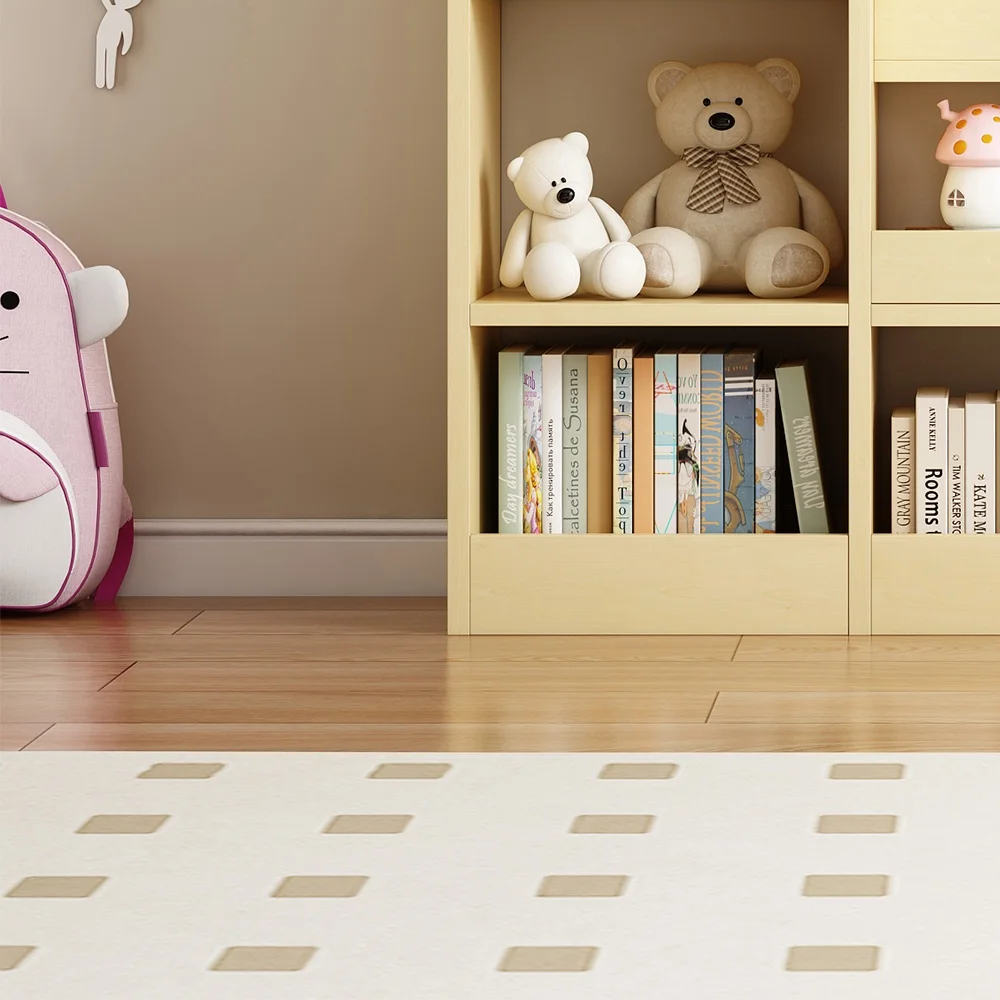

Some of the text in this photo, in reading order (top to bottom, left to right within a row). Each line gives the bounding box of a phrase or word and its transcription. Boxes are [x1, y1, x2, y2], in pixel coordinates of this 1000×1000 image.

[563, 368, 582, 431] Susana
[563, 436, 579, 455] de
[499, 423, 523, 525] Day dreamers
[547, 449, 555, 500] тренировать
[896, 430, 911, 527] GRAY MOUNTAIN
[925, 468, 943, 526] Rooms
[952, 465, 961, 480] TIM
[952, 482, 961, 518] WALKER
[974, 484, 987, 534] KATE M
